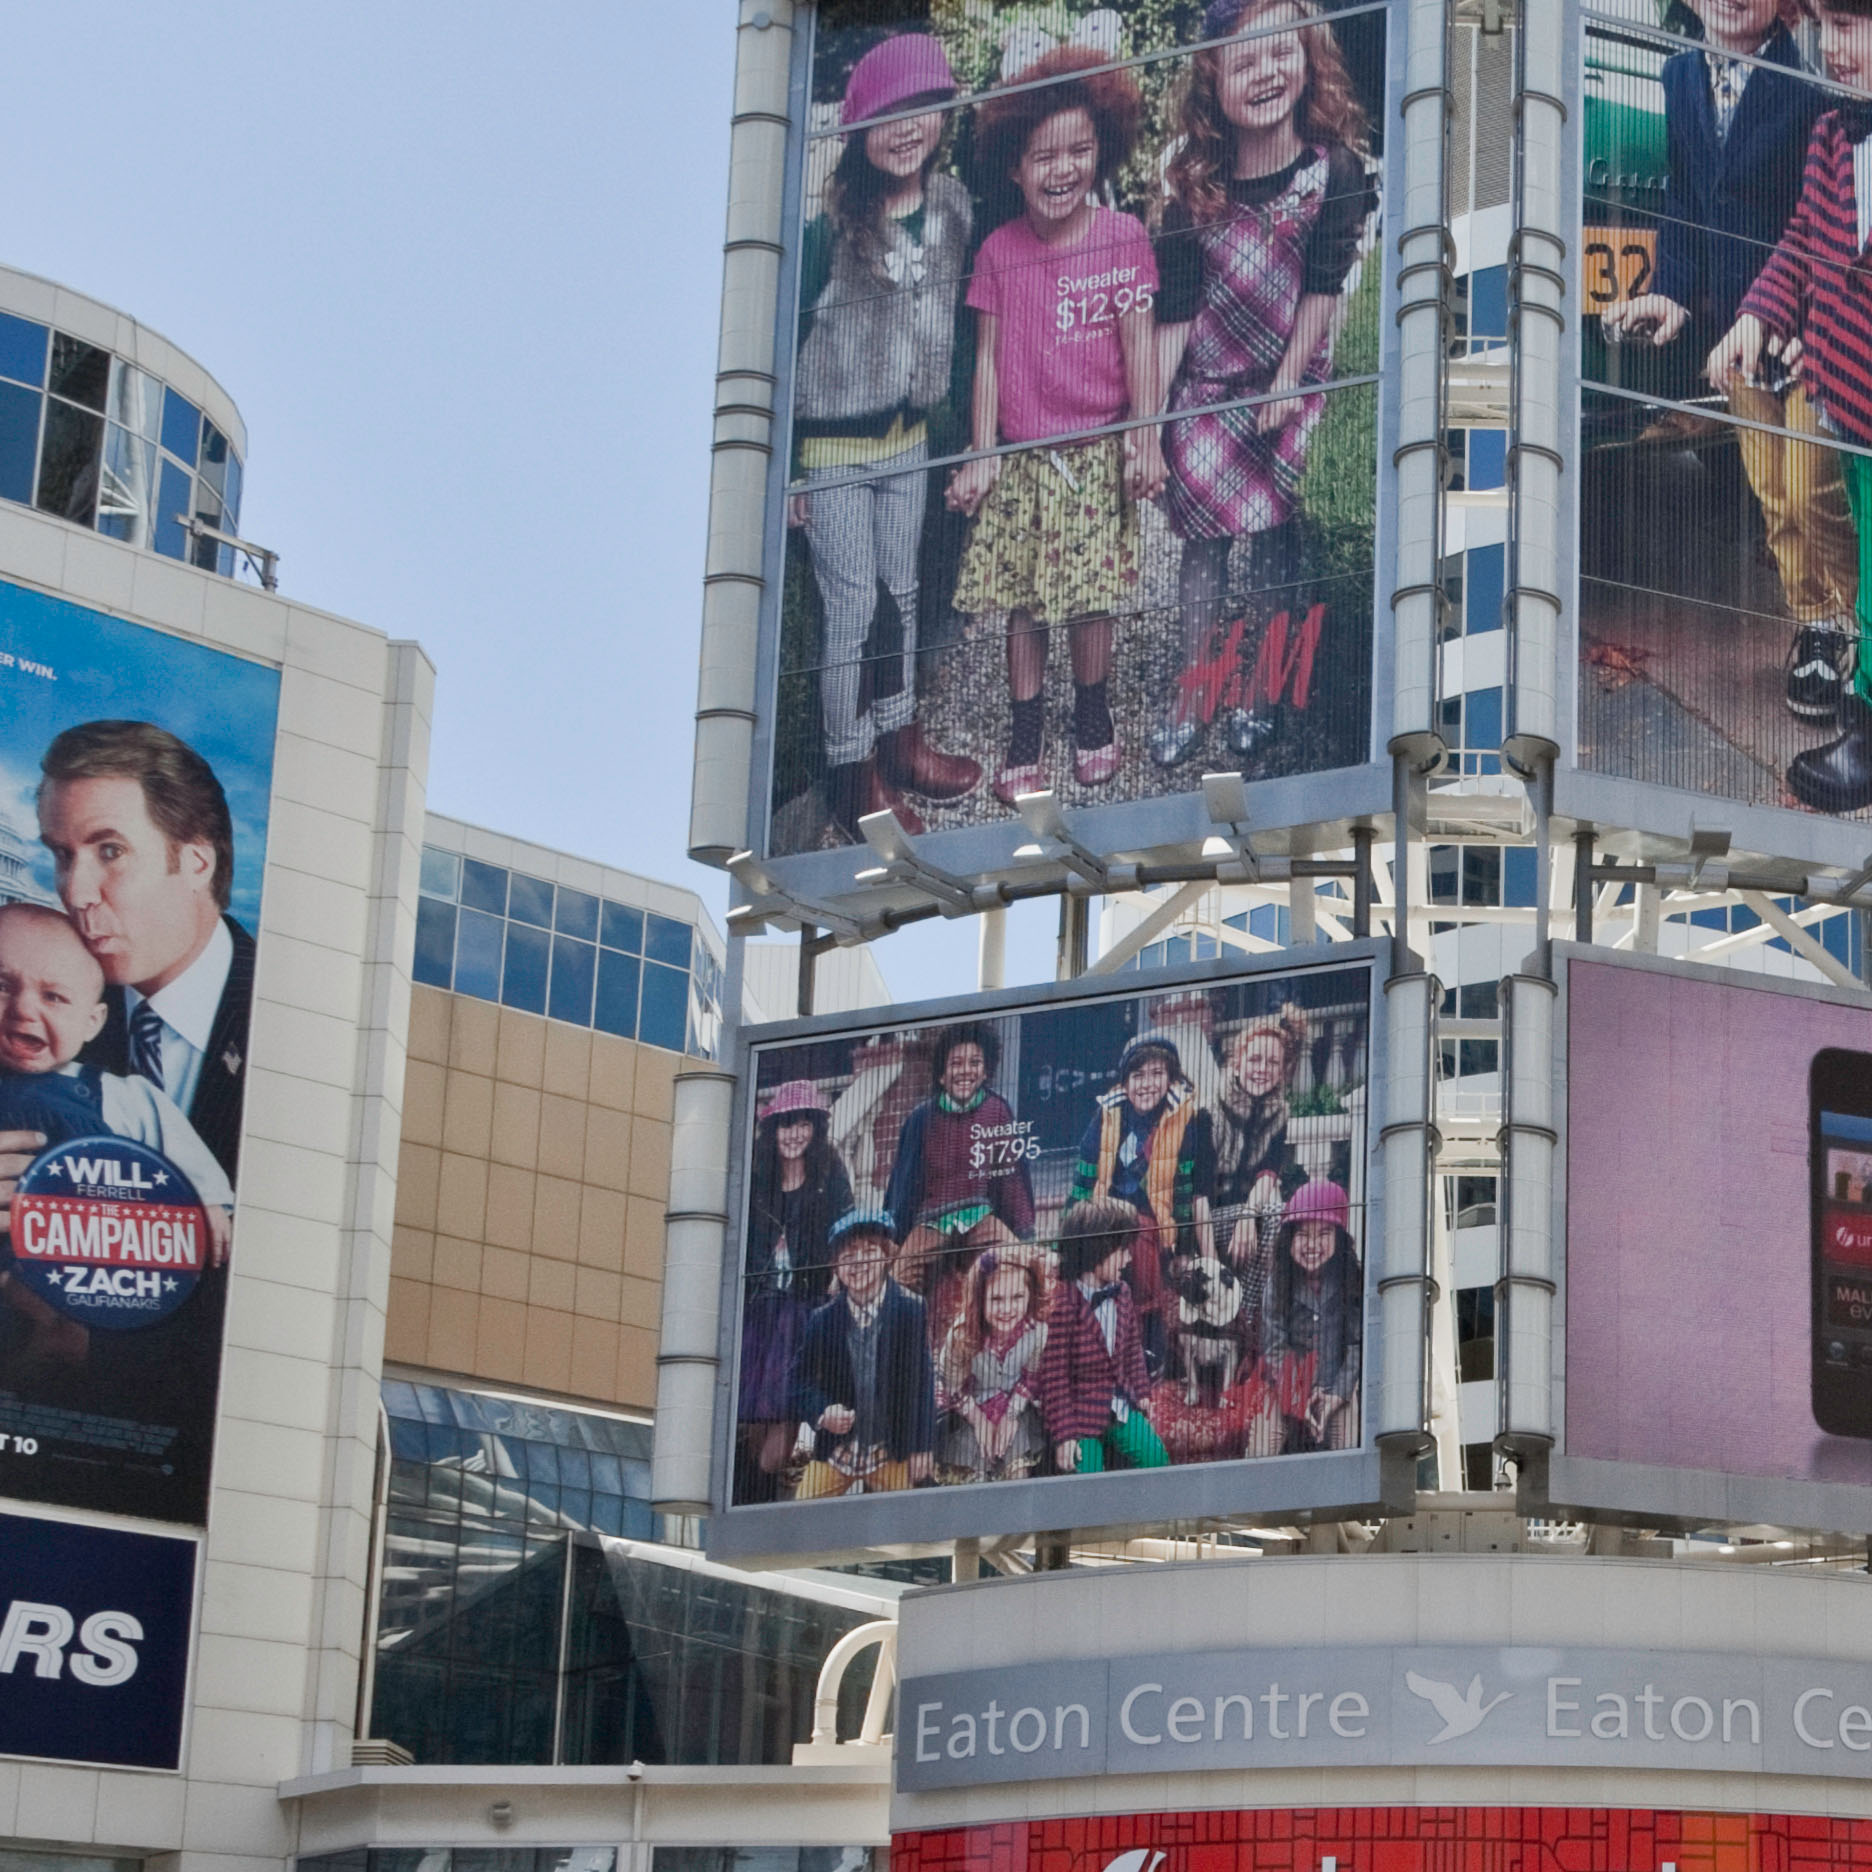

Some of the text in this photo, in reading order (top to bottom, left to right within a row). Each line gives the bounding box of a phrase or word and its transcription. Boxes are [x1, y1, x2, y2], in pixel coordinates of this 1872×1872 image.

[1057, 266, 1139, 296] Sweater
[1584, 242, 1651, 302] 32
[18, 657, 58, 681] WIN.
[970, 1121, 1034, 1140] Sweater
[969, 1136, 1041, 1169] $17.95
[64, 1155, 153, 1189] WILL
[77, 1184, 145, 1201] FERRELL
[101, 1203, 120, 1217] THE
[23, 1211, 196, 1264] CAMPAIGN
[63, 1266, 161, 1297] ZACH
[13, 1436, 38, 1455] 10
[0, 1599, 144, 1687] RS
[916, 1698, 1090, 1763] Eaton
[1119, 1681, 1369, 1746] Centre
[1546, 1677, 1761, 1745] Eaton
